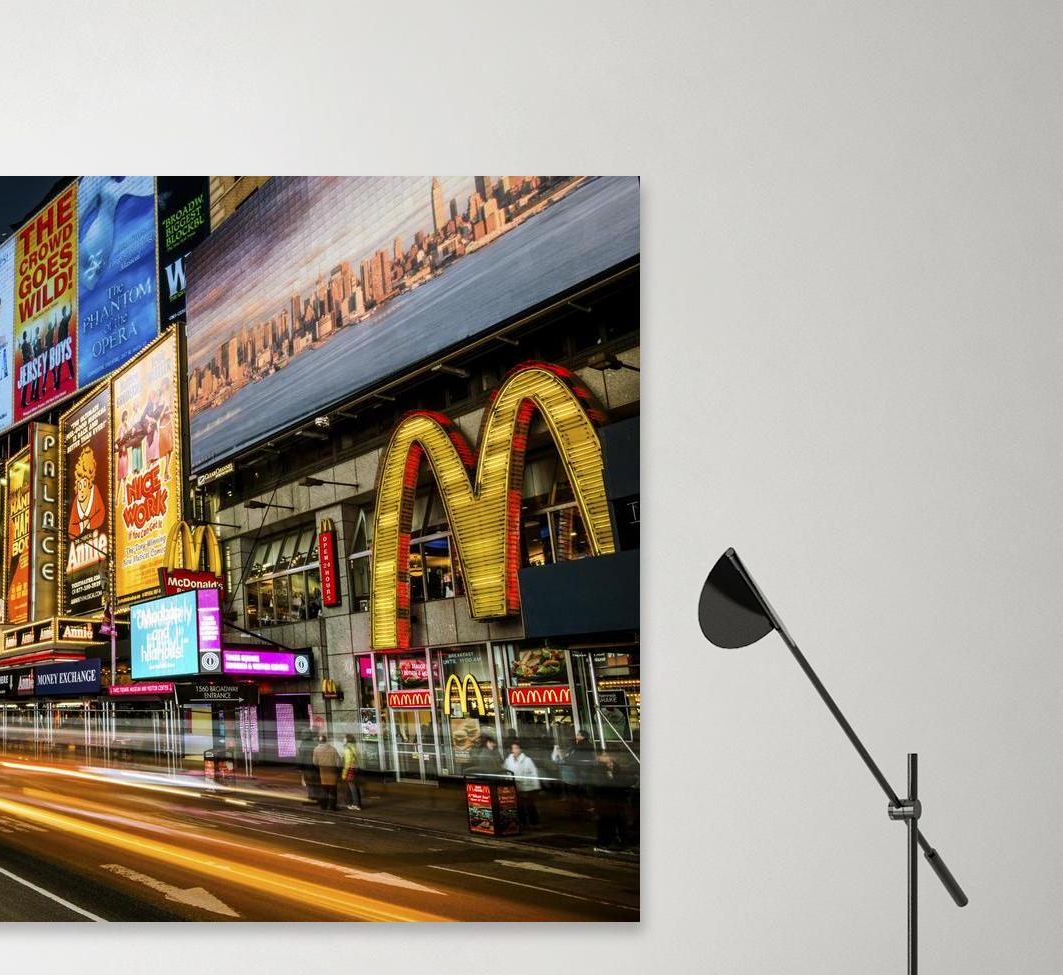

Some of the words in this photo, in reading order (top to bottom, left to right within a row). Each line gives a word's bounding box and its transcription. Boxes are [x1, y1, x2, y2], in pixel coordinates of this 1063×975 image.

[19, 188, 73, 257] THE
[18, 222, 74, 276] CROWD
[18, 241, 73, 300] GOES
[18, 264, 74, 323] WILD!
[83, 276, 152, 334] PHANTOM
[107, 282, 124, 299] The
[91, 320, 139, 359] OPERA
[18, 349, 49, 390] JERSEY
[49, 335, 72, 371] BOYS
[126, 465, 162, 505] NICE
[41, 434, 55, 581] PALACE
[122, 488, 169, 529] WORK
[66, 529, 108, 572] Annie
[167, 577, 224, 591] McDonald's
[62, 623, 94, 640] Annie
[37, 672, 58, 686] MONEY
[59, 669, 96, 684] EXCHANGE
